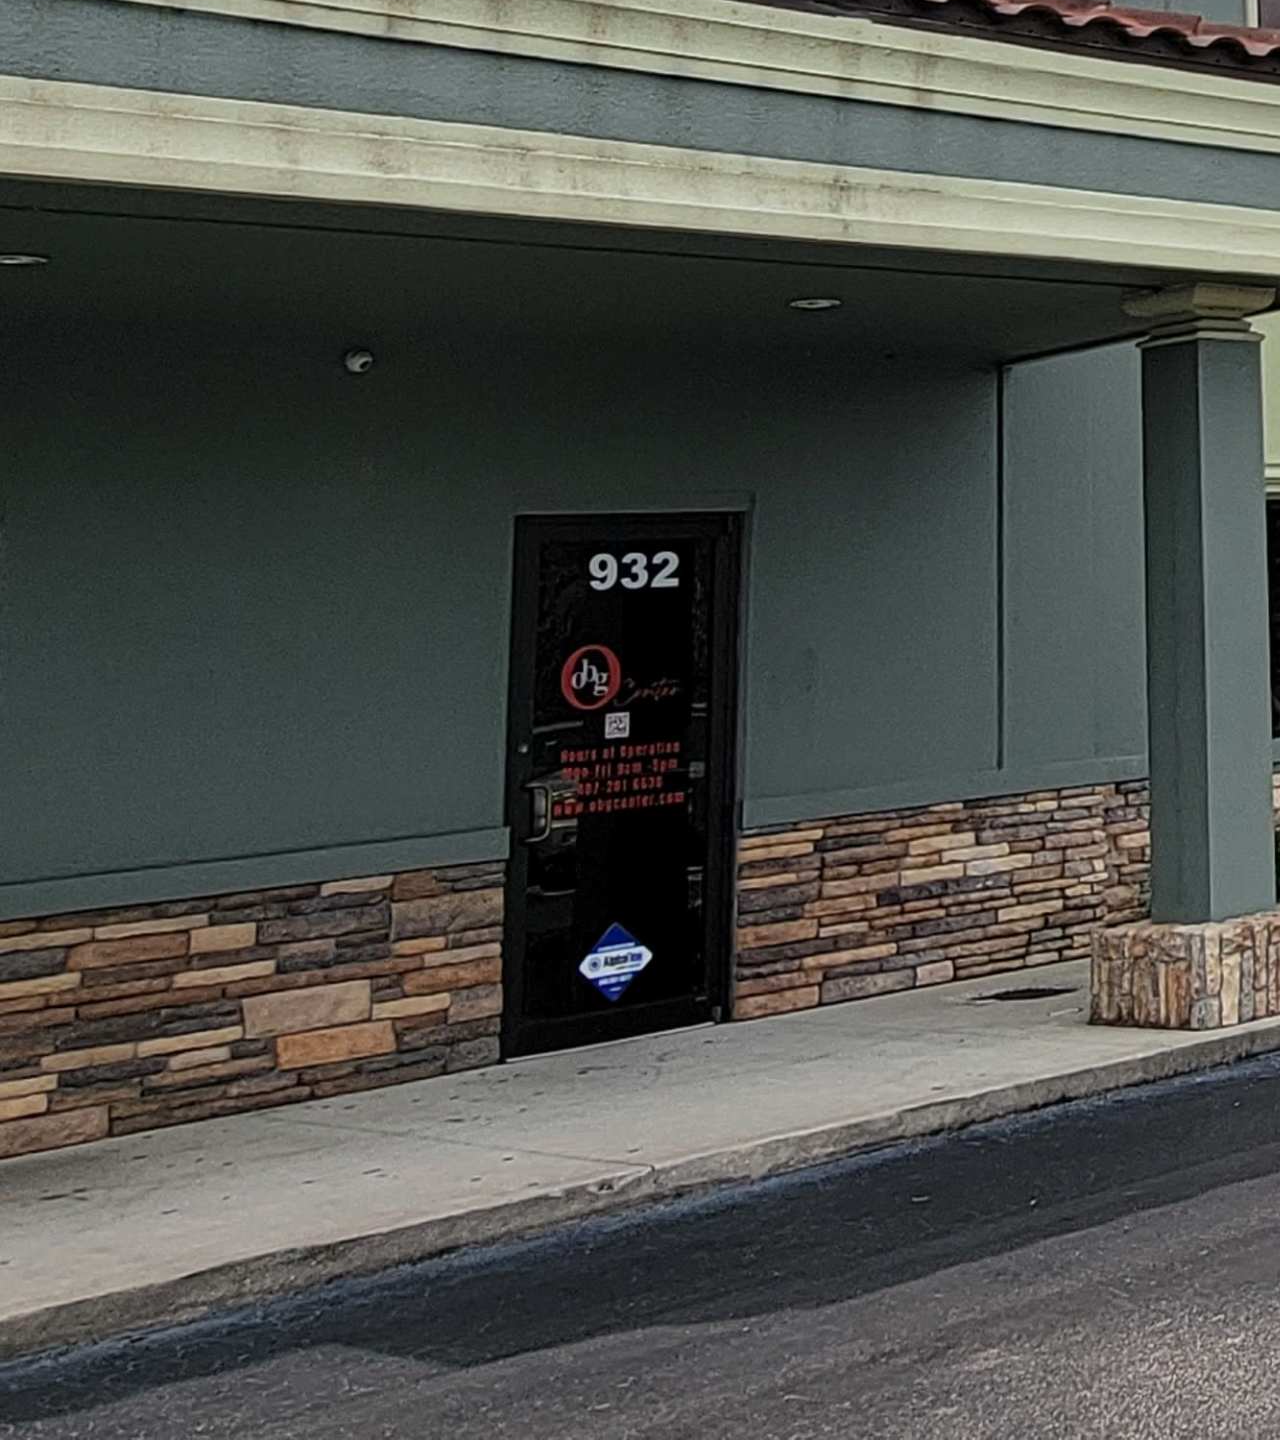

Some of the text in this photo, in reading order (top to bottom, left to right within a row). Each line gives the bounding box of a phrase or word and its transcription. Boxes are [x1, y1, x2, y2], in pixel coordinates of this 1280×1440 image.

[588, 551, 679, 591] 932
[560, 741, 681, 763] Hours of Operation
